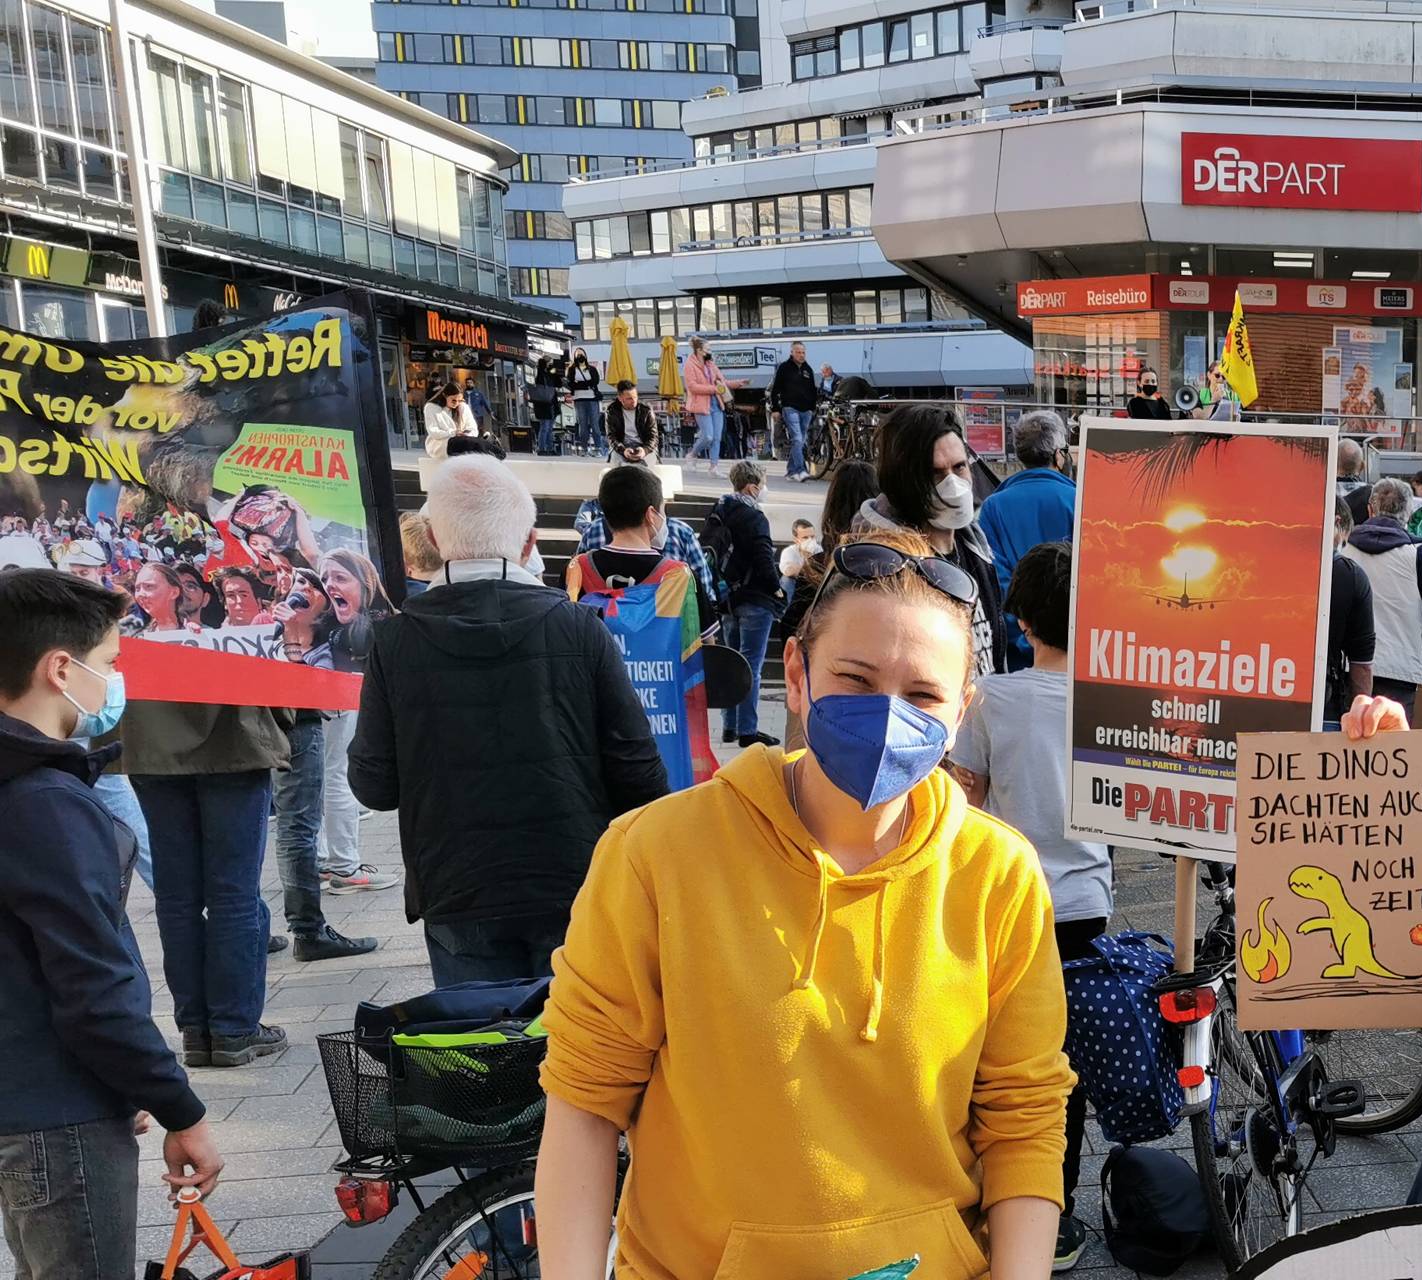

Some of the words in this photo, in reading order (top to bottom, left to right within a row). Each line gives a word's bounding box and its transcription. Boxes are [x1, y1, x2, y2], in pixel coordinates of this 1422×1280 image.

[1193, 147, 1346, 195] DERPART
[1020, 288, 1067, 309] DERPART
[1087, 289, 1147, 306] Reisebüro
[1320, 293, 1334, 302] ITS
[427, 310, 489, 350] Merzenich
[759, 350, 774, 362] Tee
[626, 660, 674, 682] TIGKEIT
[1089, 628, 1296, 697] Klimaziele
[1151, 696, 1221, 725] schnell
[1095, 725, 1198, 755] erreichbar
[1196, 737, 1236, 759] mac
[1152, 760, 1182, 772] PARTEI
[1188, 765, 1198, 774] für
[1198, 767, 1218, 776] Europa
[1251, 752, 1306, 781] DIE
[1317, 748, 1409, 781] DINOS
[1092, 777, 1122, 808] Die
[1124, 782, 1236, 834] PART
[1248, 793, 1370, 820] DACHTEN
[1251, 822, 1295, 845] SIE
[1303, 820, 1403, 847] HÄTTEN
[1352, 856, 1415, 883] NOCH
